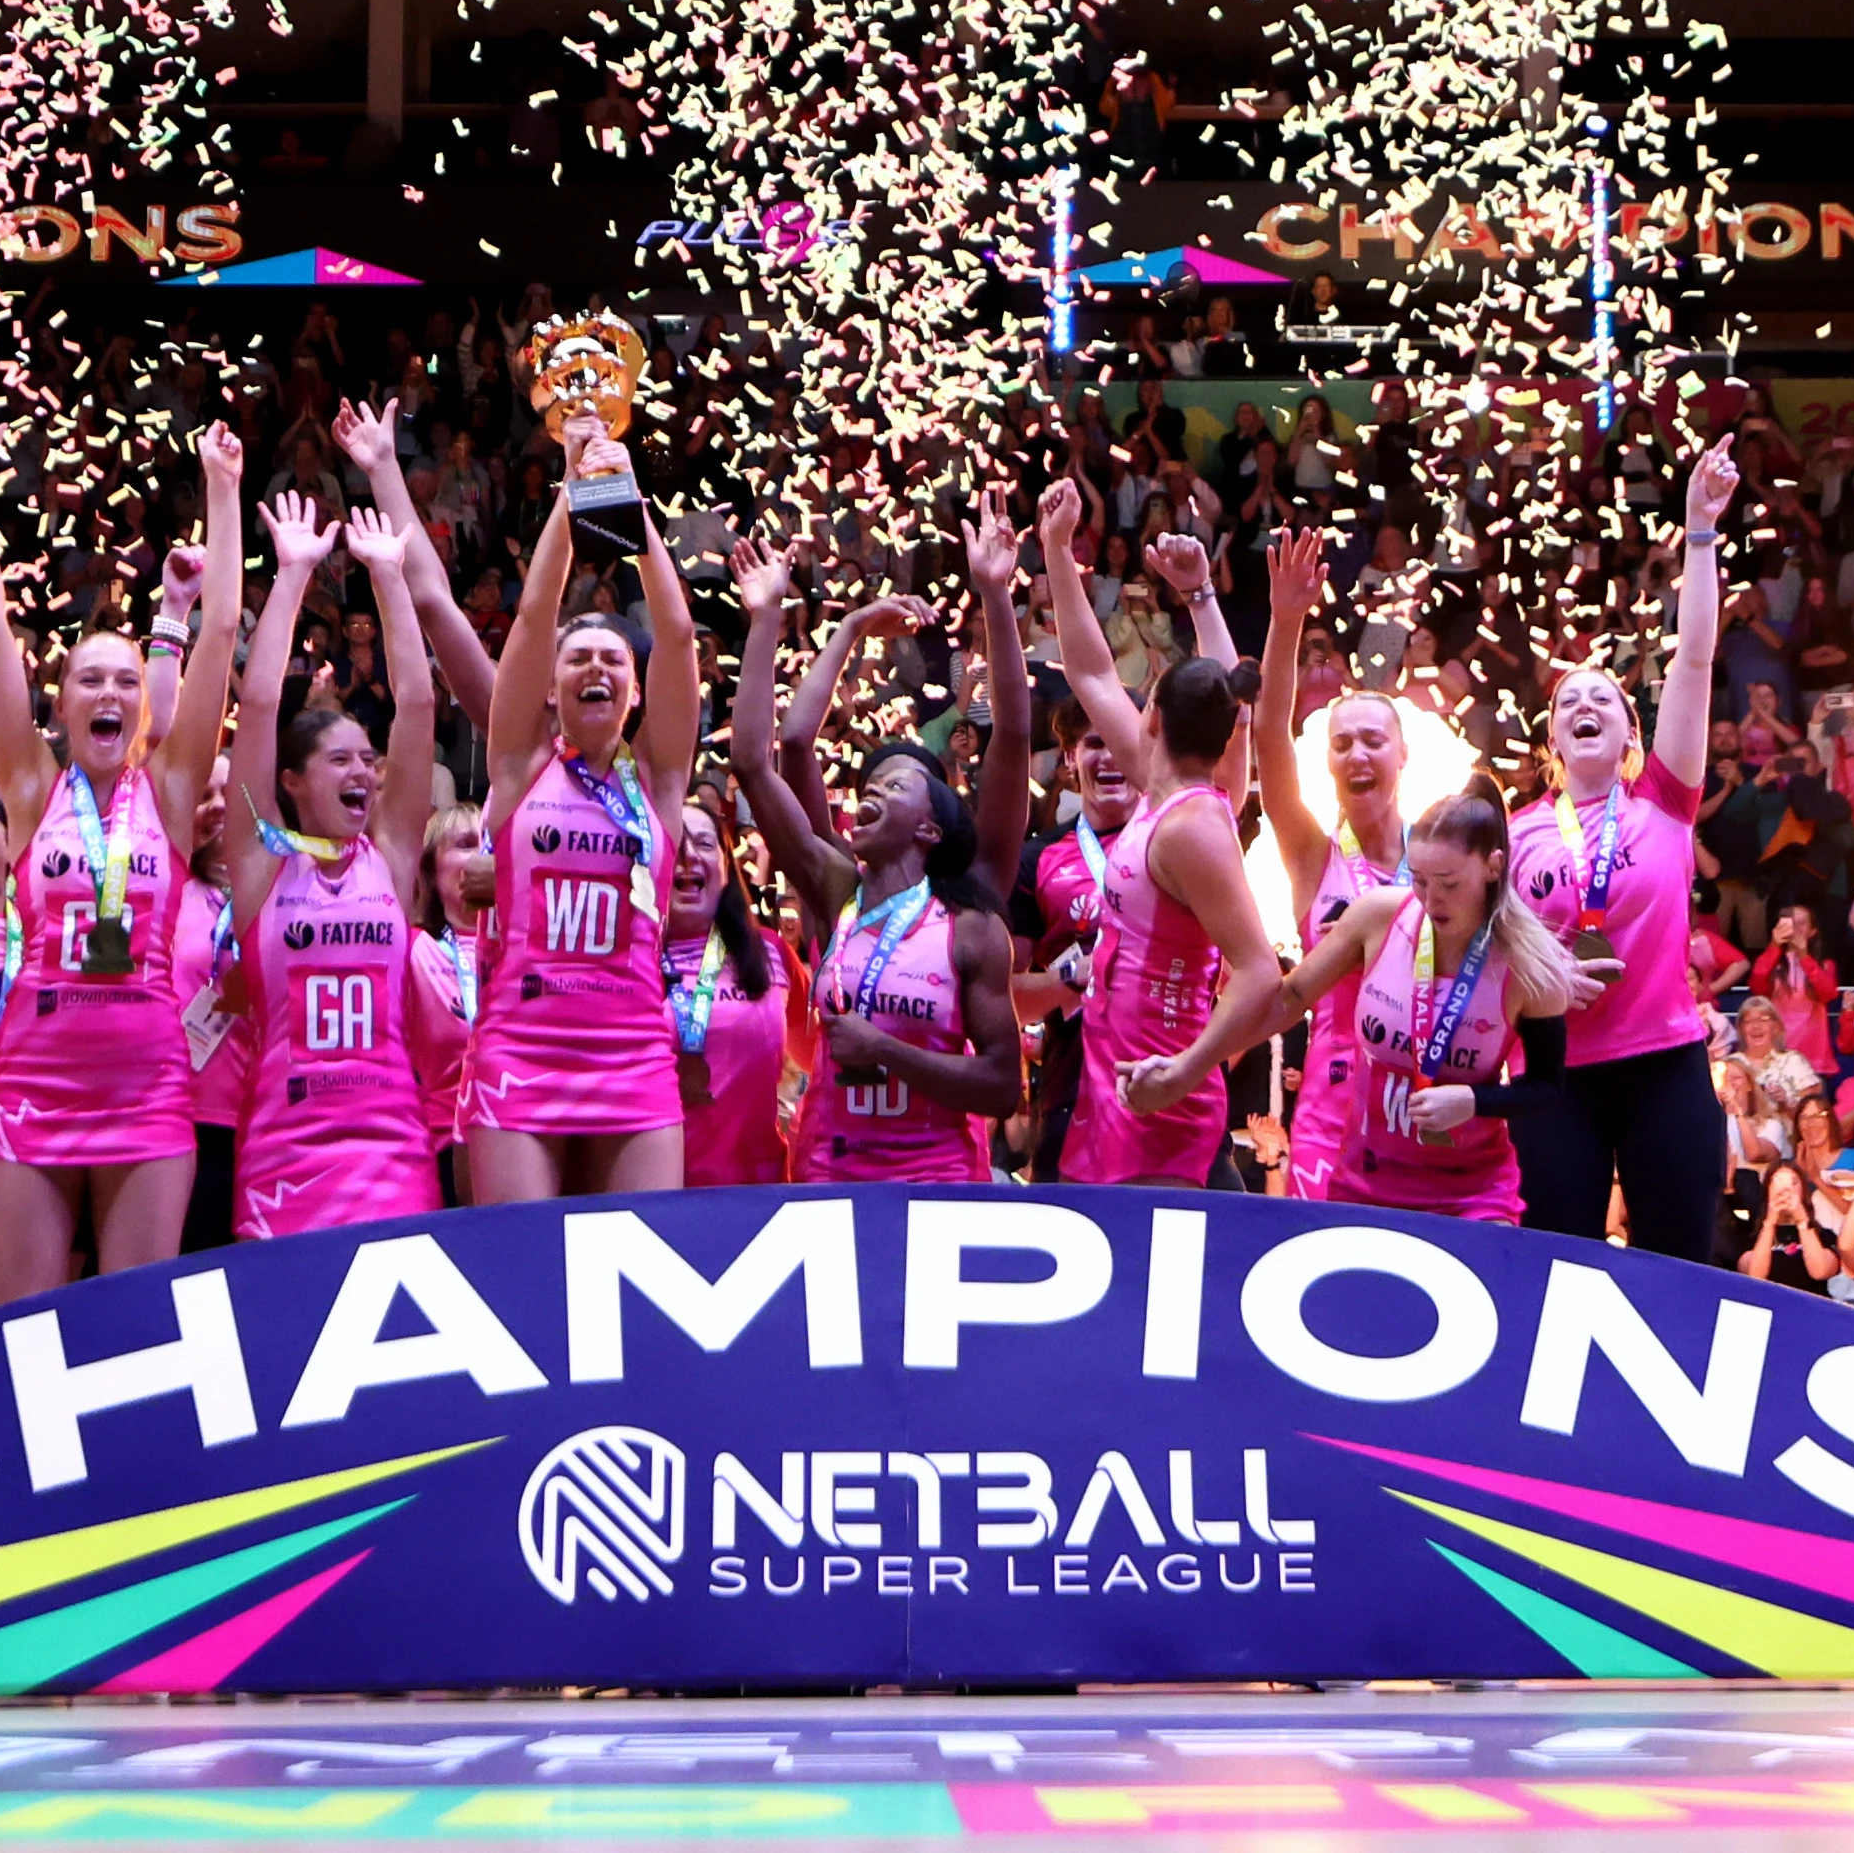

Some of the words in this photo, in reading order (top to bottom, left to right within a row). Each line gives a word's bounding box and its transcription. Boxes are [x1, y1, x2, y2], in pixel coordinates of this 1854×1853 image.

[78, 853, 159, 882] FACE
[1594, 820, 1618, 889] GRAND
[321, 920, 394, 947] FATFACE
[544, 878, 620, 955] WD
[305, 974, 374, 1051] GA
[855, 953, 887, 1018] RAND
[872, 991, 939, 1022] ATFACE
[1428, 983, 1469, 1061] GRAND
[711, 1446, 1316, 1547] NETBALL
[709, 1551, 969, 1599] SUPER
[1007, 1549, 1316, 1597] LEAGUE
